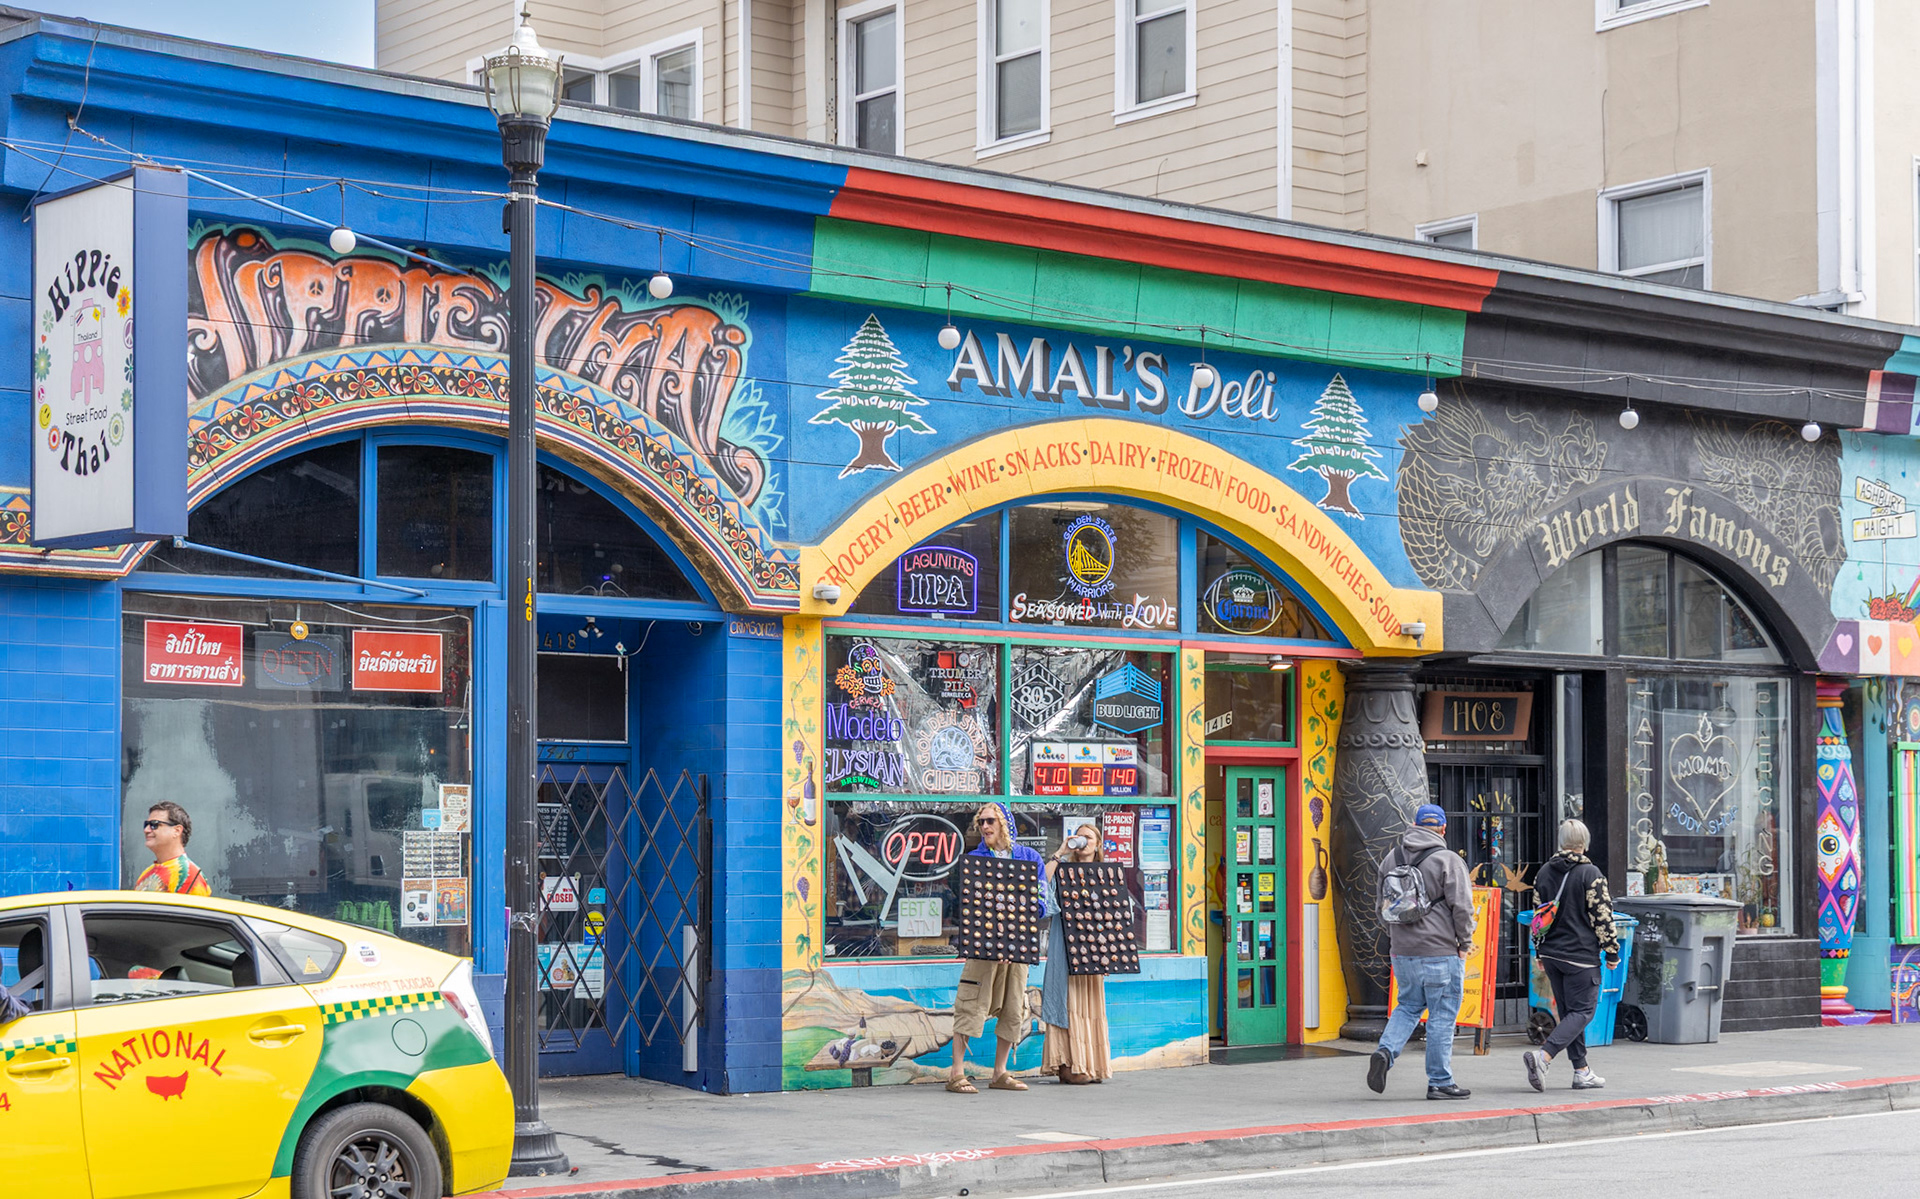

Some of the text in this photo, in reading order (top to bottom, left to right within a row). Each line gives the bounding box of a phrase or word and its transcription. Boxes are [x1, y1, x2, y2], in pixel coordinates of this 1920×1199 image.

[77, 330, 98, 341] Thailand
[946, 328, 1280, 422] AMAL'S Deli
[65, 405, 107, 426] Street Food
[60, 429, 110, 476] Thai
[1860, 483, 1902, 511] ASHBURY
[897, 482, 948, 528] BEER
[947, 458, 1000, 497] WINE
[1005, 441, 1082, 477] SNACKS
[1089, 440, 1151, 470] DAIRY
[1156, 449, 1225, 492] FROZEN
[1225, 475, 1271, 515] FOOD
[1275, 504, 1373, 602] SANDWICHES
[1063, 515, 1118, 545] GOLDEN STATE
[1863, 516, 1903, 537] HAIGHT
[1538, 485, 1791, 588] World Famous
[904, 552, 974, 577] LAGUNITAS
[910, 573, 968, 607] IPA
[1066, 576, 1116, 599] WARRIORS
[524, 577, 533, 622] 146
[1010, 592, 1177, 629] SEASONED WITH LOVE
[1216, 596, 1270, 623] Corona
[150, 656, 239, 681] อาหารตามสั่ง
[262, 648, 332, 677] OPEN
[358, 650, 438, 674] ยินดีต้อนรับ
[929, 667, 983, 680] TRUMER
[943, 681, 971, 692] PILS
[1020, 685, 1053, 705] 805
[849, 695, 884, 711] CERVEZA
[1096, 704, 1161, 719] BUD LIGHT
[827, 702, 904, 741] Modelo
[1206, 713, 1232, 734] 1416
[917, 709, 957, 767] GOLDEN
[841, 776, 880, 788] BREWING
[922, 769, 980, 793] CIDER
[1081, 767, 1102, 785] 30
[1110, 767, 1136, 785] 140
[1042, 785, 1063, 793] MILLION
[1077, 785, 1098, 793] MILLION
[1111, 786, 1132, 794] MILLION
[1104, 815, 1133, 824] 12-PACKS
[1670, 802, 1739, 835] BODY SHOP
[1104, 825, 1132, 836] $12.99
[886, 832, 957, 864] OPEN
[900, 900, 940, 916] EBT &
[905, 920, 935, 935] ATM
[393, 976, 435, 991] TAXICAB
[93, 1029, 227, 1091] NATIONAL
